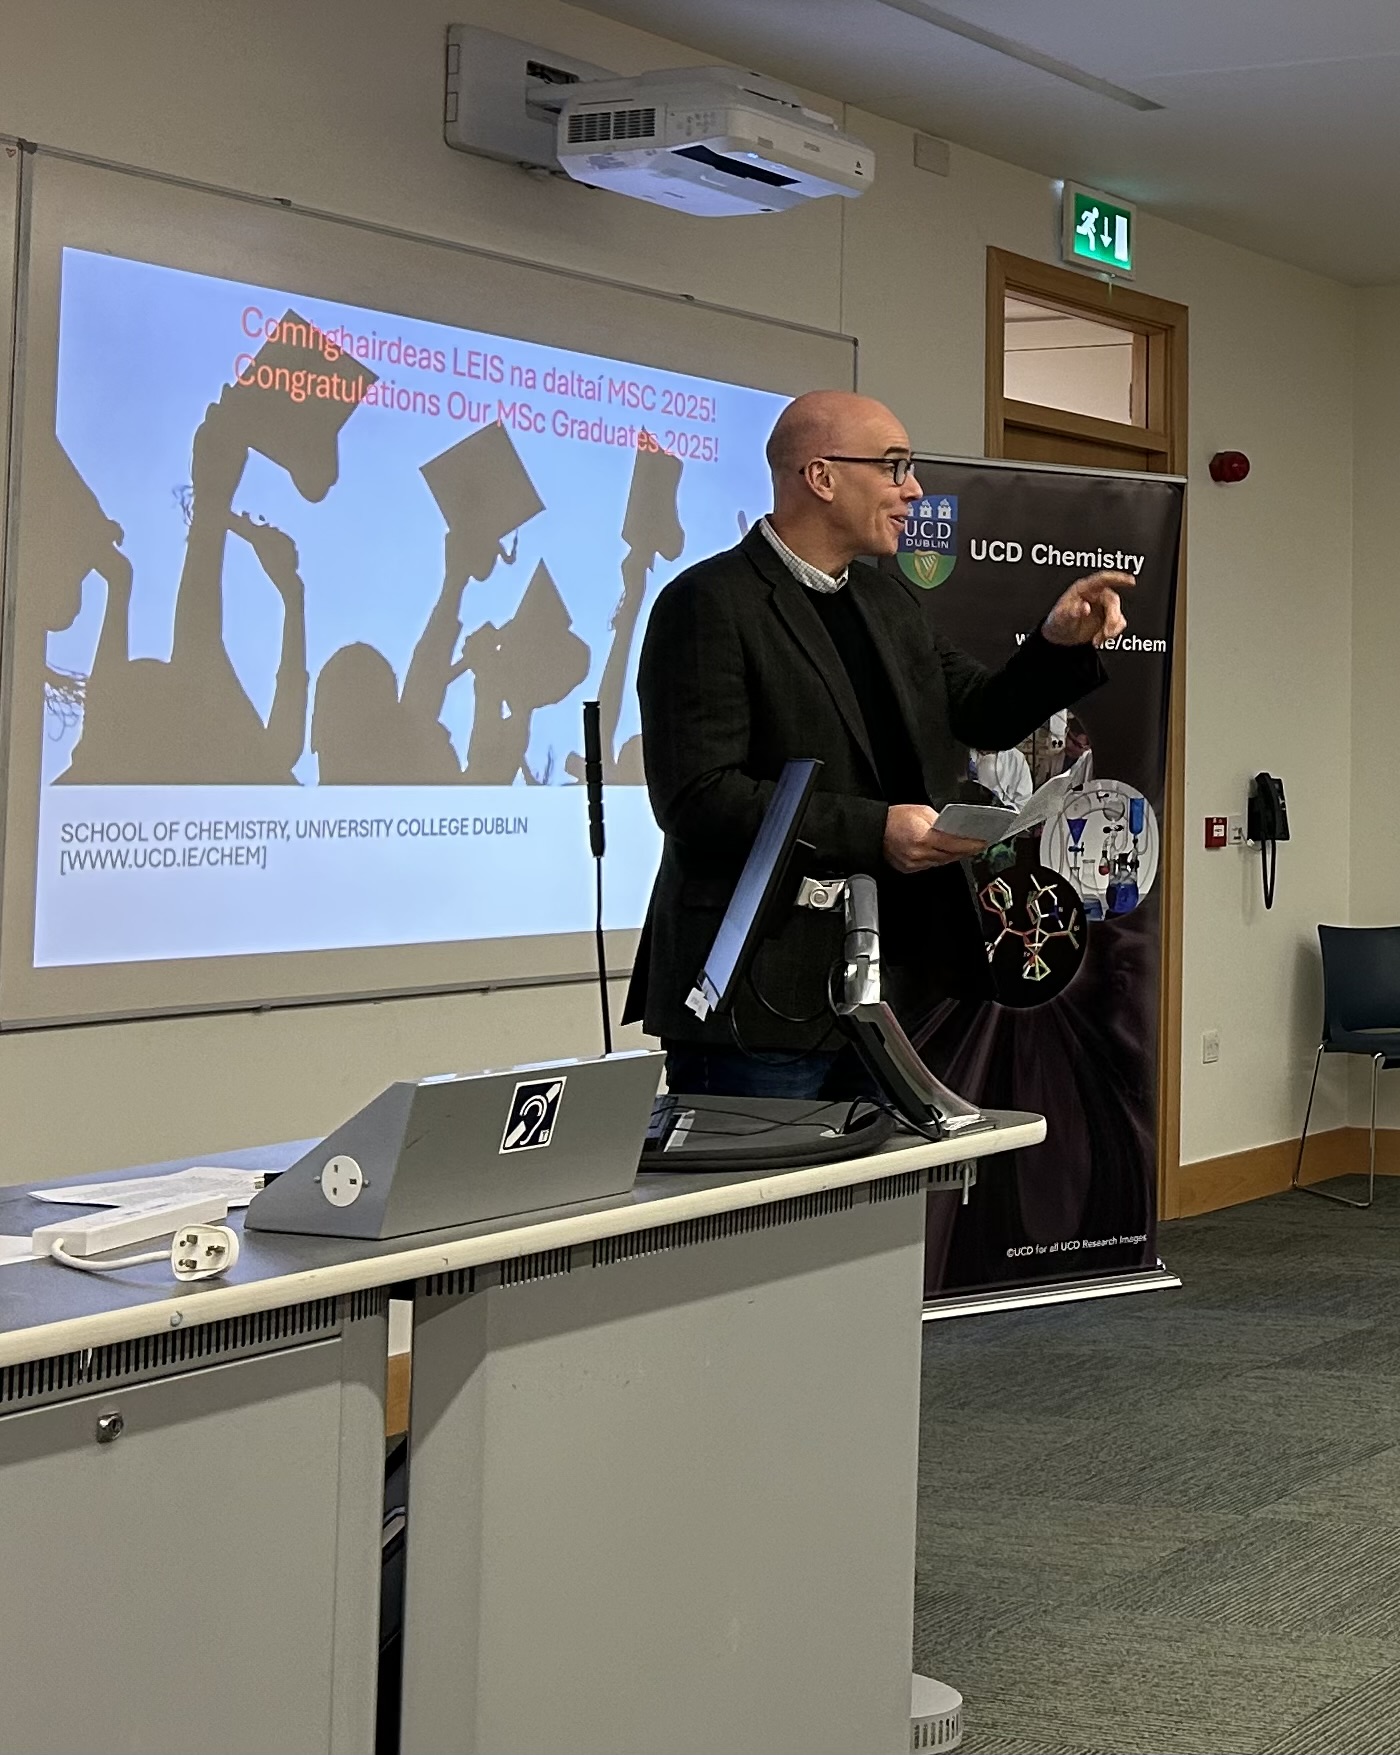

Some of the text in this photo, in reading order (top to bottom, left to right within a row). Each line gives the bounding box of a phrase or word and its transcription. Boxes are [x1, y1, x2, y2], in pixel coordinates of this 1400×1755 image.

[241, 306, 717, 423] Comhghairdeas LEIS na daltaí MSC 2025!
[233, 353, 719, 463] Congratulations Our MSc Graduates 2025!
[904, 519, 951, 539] UCD
[905, 538, 949, 549] DUBLIN
[971, 539, 1145, 575] UCD Chemistry
[60, 816, 528, 843] SCHOOL OF CHEMISTRY, UNIVERSITY COLLEGE DUBLIN
[60, 845, 268, 876] [WWW.UCD.IE/CHEM]
[1036, 1244, 1048, 1254] for
[1050, 1242, 1059, 1253] all
[1061, 1240, 1081, 1251] UCD
[1082, 1236, 1118, 1249] Research
[1119, 1233, 1148, 1245] Images
